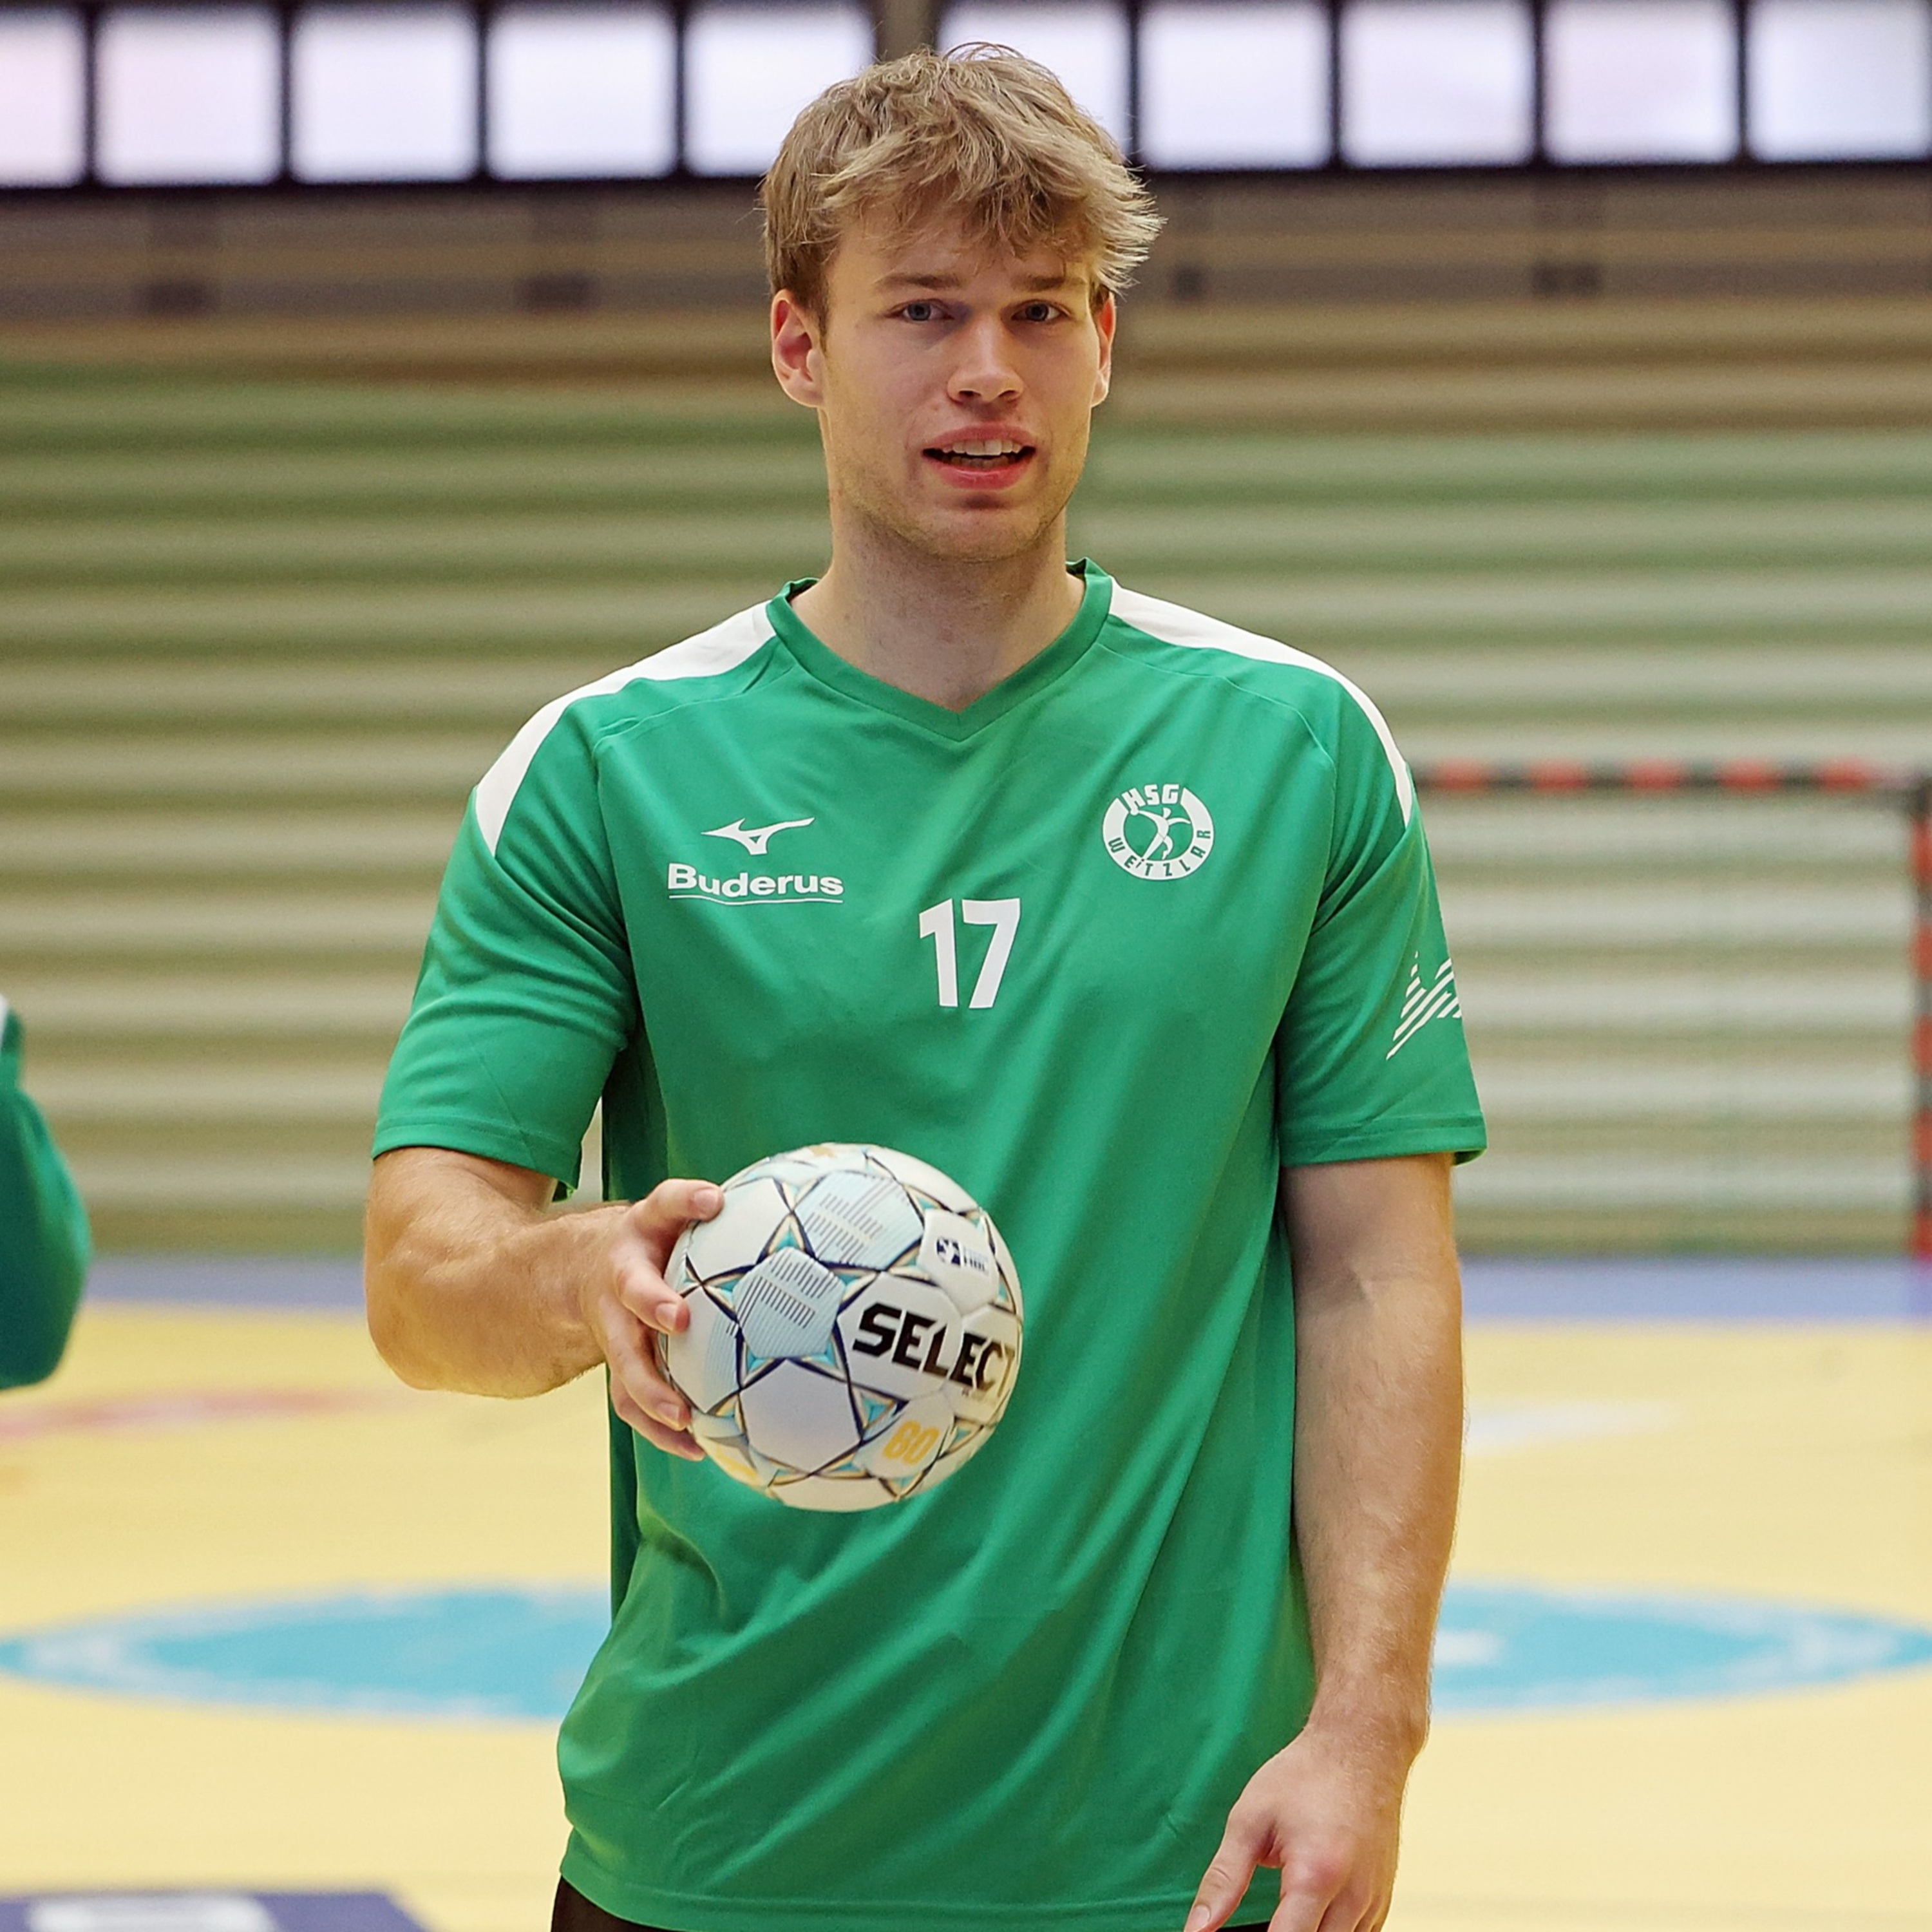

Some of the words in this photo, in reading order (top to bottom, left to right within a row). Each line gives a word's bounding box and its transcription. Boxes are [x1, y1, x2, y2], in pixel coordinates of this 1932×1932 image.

[1121, 784, 1180, 810] HSG
[1107, 829, 1211, 878] WETZLAR
[668, 862, 844, 897] Buderus
[918, 898, 1021, 1009] 17
[852, 1302, 1016, 1399] SELECT
